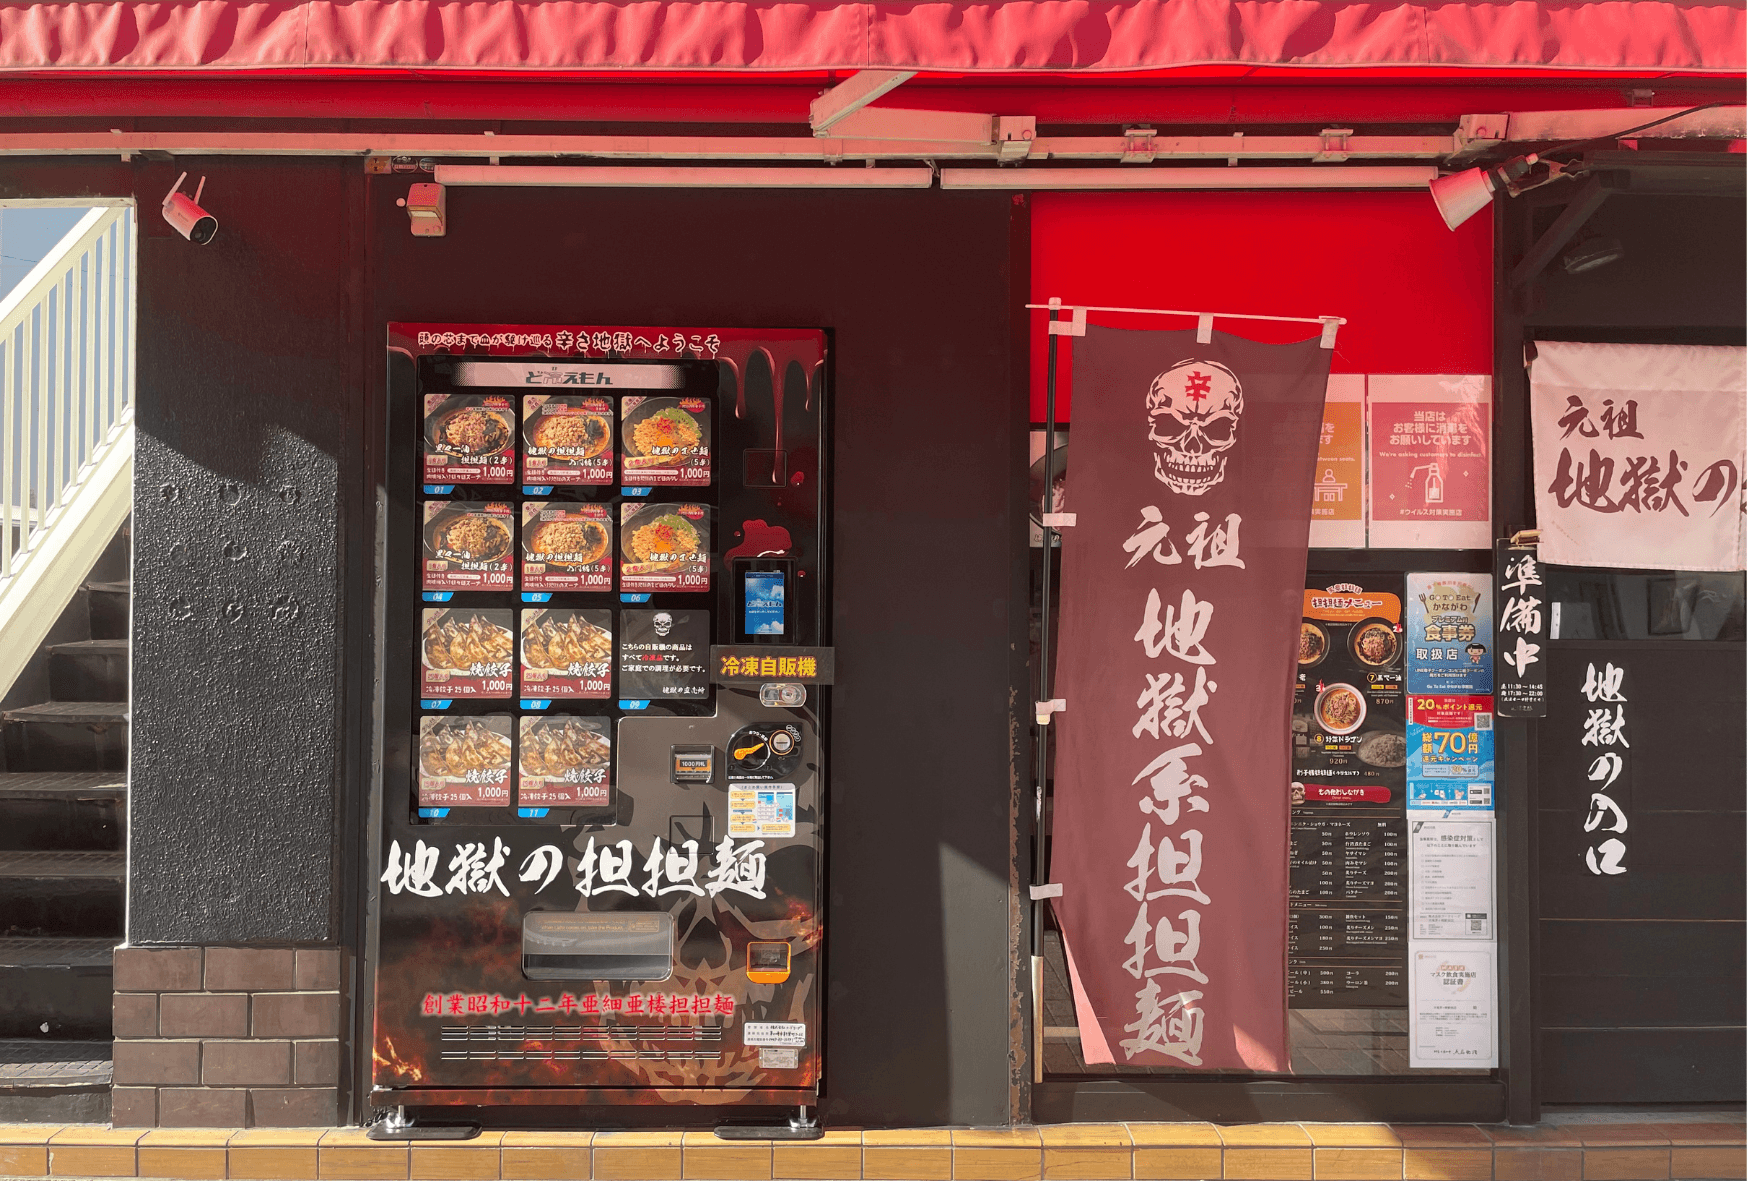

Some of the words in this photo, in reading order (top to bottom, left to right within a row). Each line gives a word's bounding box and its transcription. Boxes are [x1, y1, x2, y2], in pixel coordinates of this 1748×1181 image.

[1184, 370, 1212, 402] 辛
[1413, 411, 1446, 422] 当店は
[1557, 395, 1645, 440] 元祖
[1393, 422, 1468, 434] お客様に消毒を
[1389, 434, 1472, 446] お願いしています
[482, 467, 513, 478] 1,000円
[582, 469, 613, 480] 1,000円
[680, 468, 710, 480] 1,000円
[1547, 447, 1747, 519] 地獄の
[1122, 505, 1246, 570] 元祖
[482, 573, 513, 584] 1,000円
[580, 575, 611, 585] 1,000円
[677, 575, 708, 585] 1,000円
[1432, 603, 1468, 611] かながわ
[1500, 554, 1543, 679] 準備中
[1424, 624, 1476, 642] 食事券
[1416, 648, 1459, 660] 取扱店
[470, 662, 512, 677] 焼餃子
[567, 662, 610, 677] 焼餃子
[720, 656, 818, 678] 冷凍自販機
[482, 680, 512, 691] 1,000円
[579, 680, 611, 691] 1,000円
[1434, 731, 1467, 755] 70
[465, 769, 508, 784] 焼餃子
[563, 768, 607, 784] 焼餃子
[477, 786, 509, 798] 1,000円
[576, 786, 607, 798] 1,000円
[1119, 587, 1218, 1067] 地獄系担担麺
[379, 835, 768, 900] 地獄の担担麺
[421, 993, 735, 1017] 創業昭和十二年亜細亜楼担担麺
